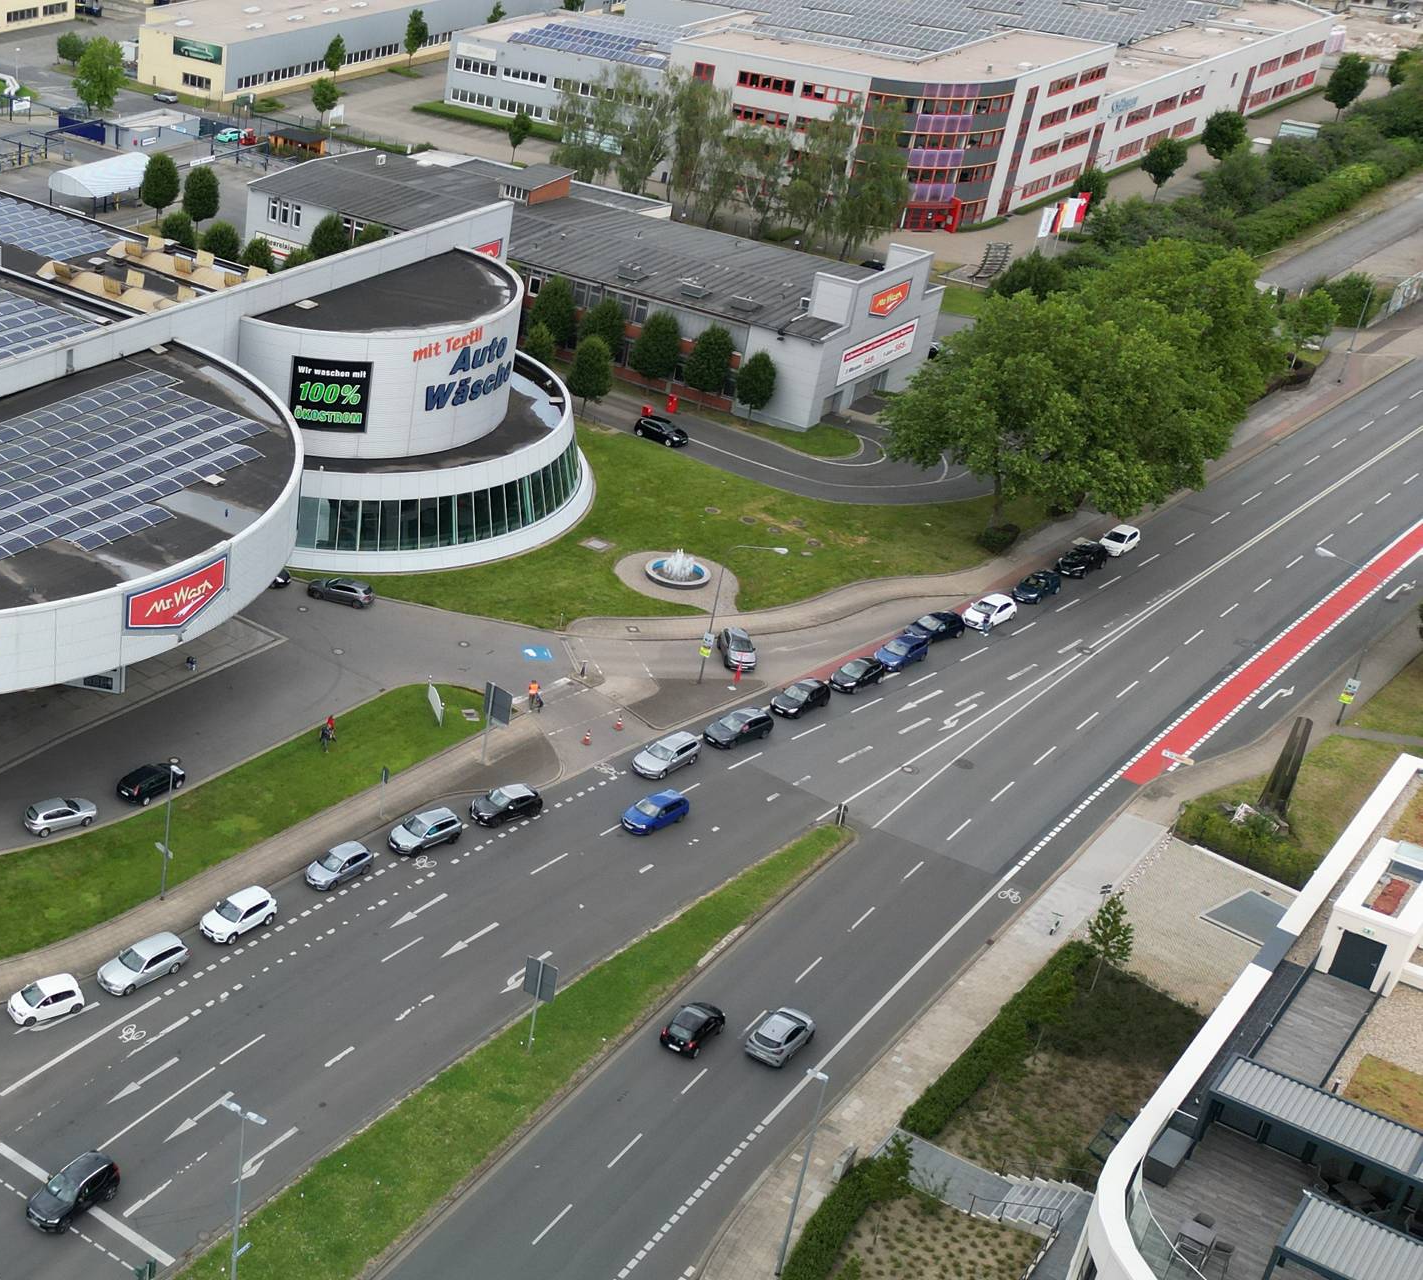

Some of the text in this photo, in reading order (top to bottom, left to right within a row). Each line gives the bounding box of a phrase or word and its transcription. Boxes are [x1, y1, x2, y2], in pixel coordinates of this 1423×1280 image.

[413, 326, 484, 362] mit Textil
[449, 336, 508, 376] Auto
[298, 366, 367, 379] Wir waschen mit
[425, 361, 512, 412] Wäsche
[299, 381, 362, 405] 100%
[294, 405, 363, 424] ÖKOSTROM
